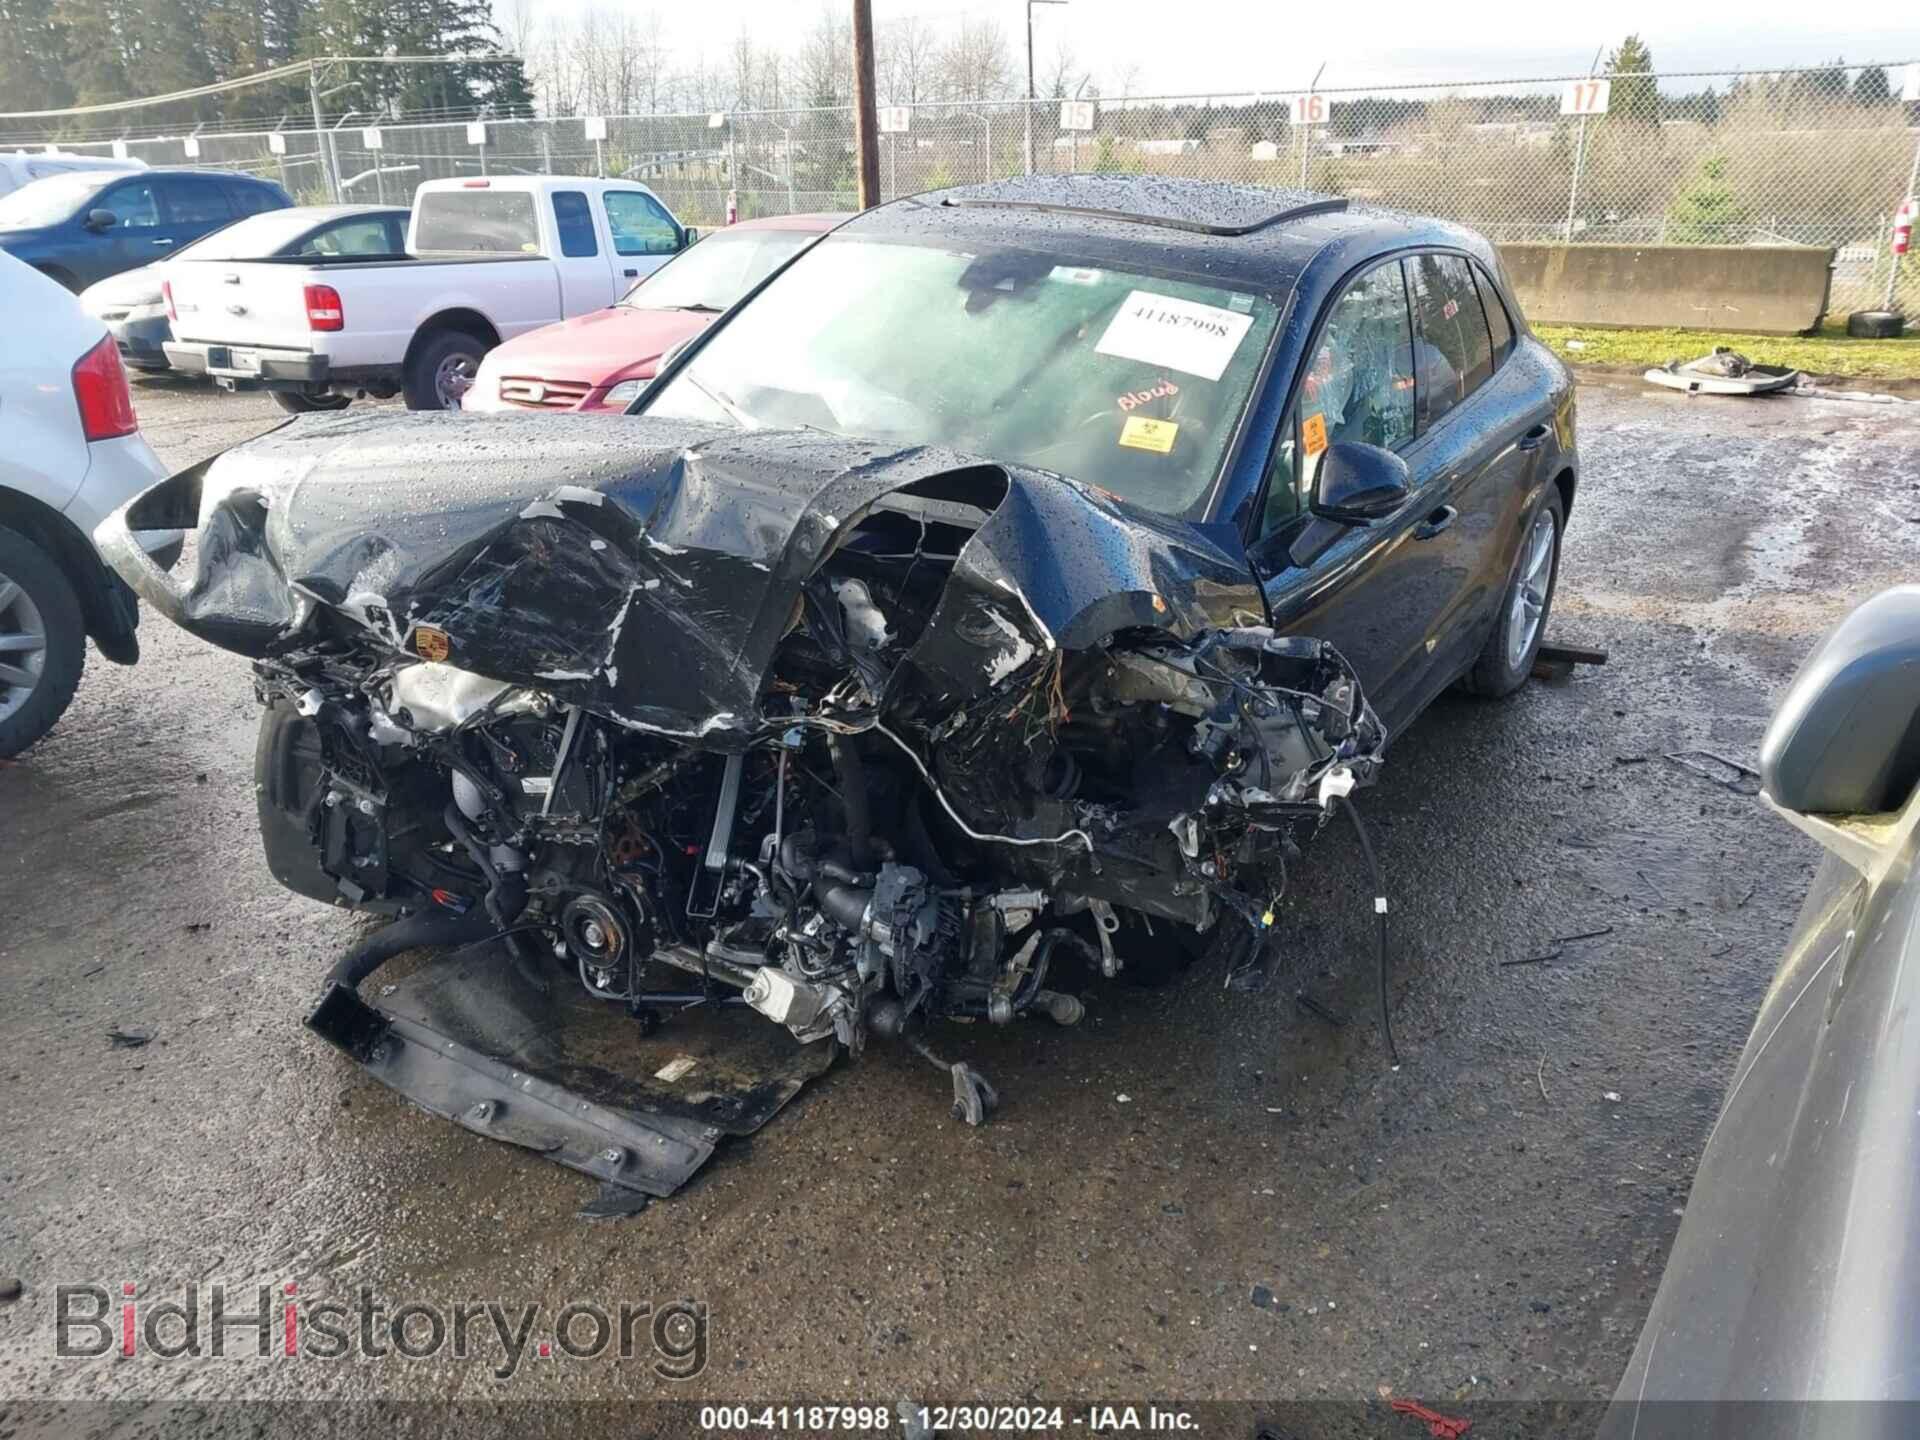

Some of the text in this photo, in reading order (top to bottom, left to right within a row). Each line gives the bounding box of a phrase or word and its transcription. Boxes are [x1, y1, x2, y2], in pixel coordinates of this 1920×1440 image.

[1298, 95, 1323, 121] 16
[1573, 82, 1601, 111] 17
[1131, 306, 1229, 337] 41187998
